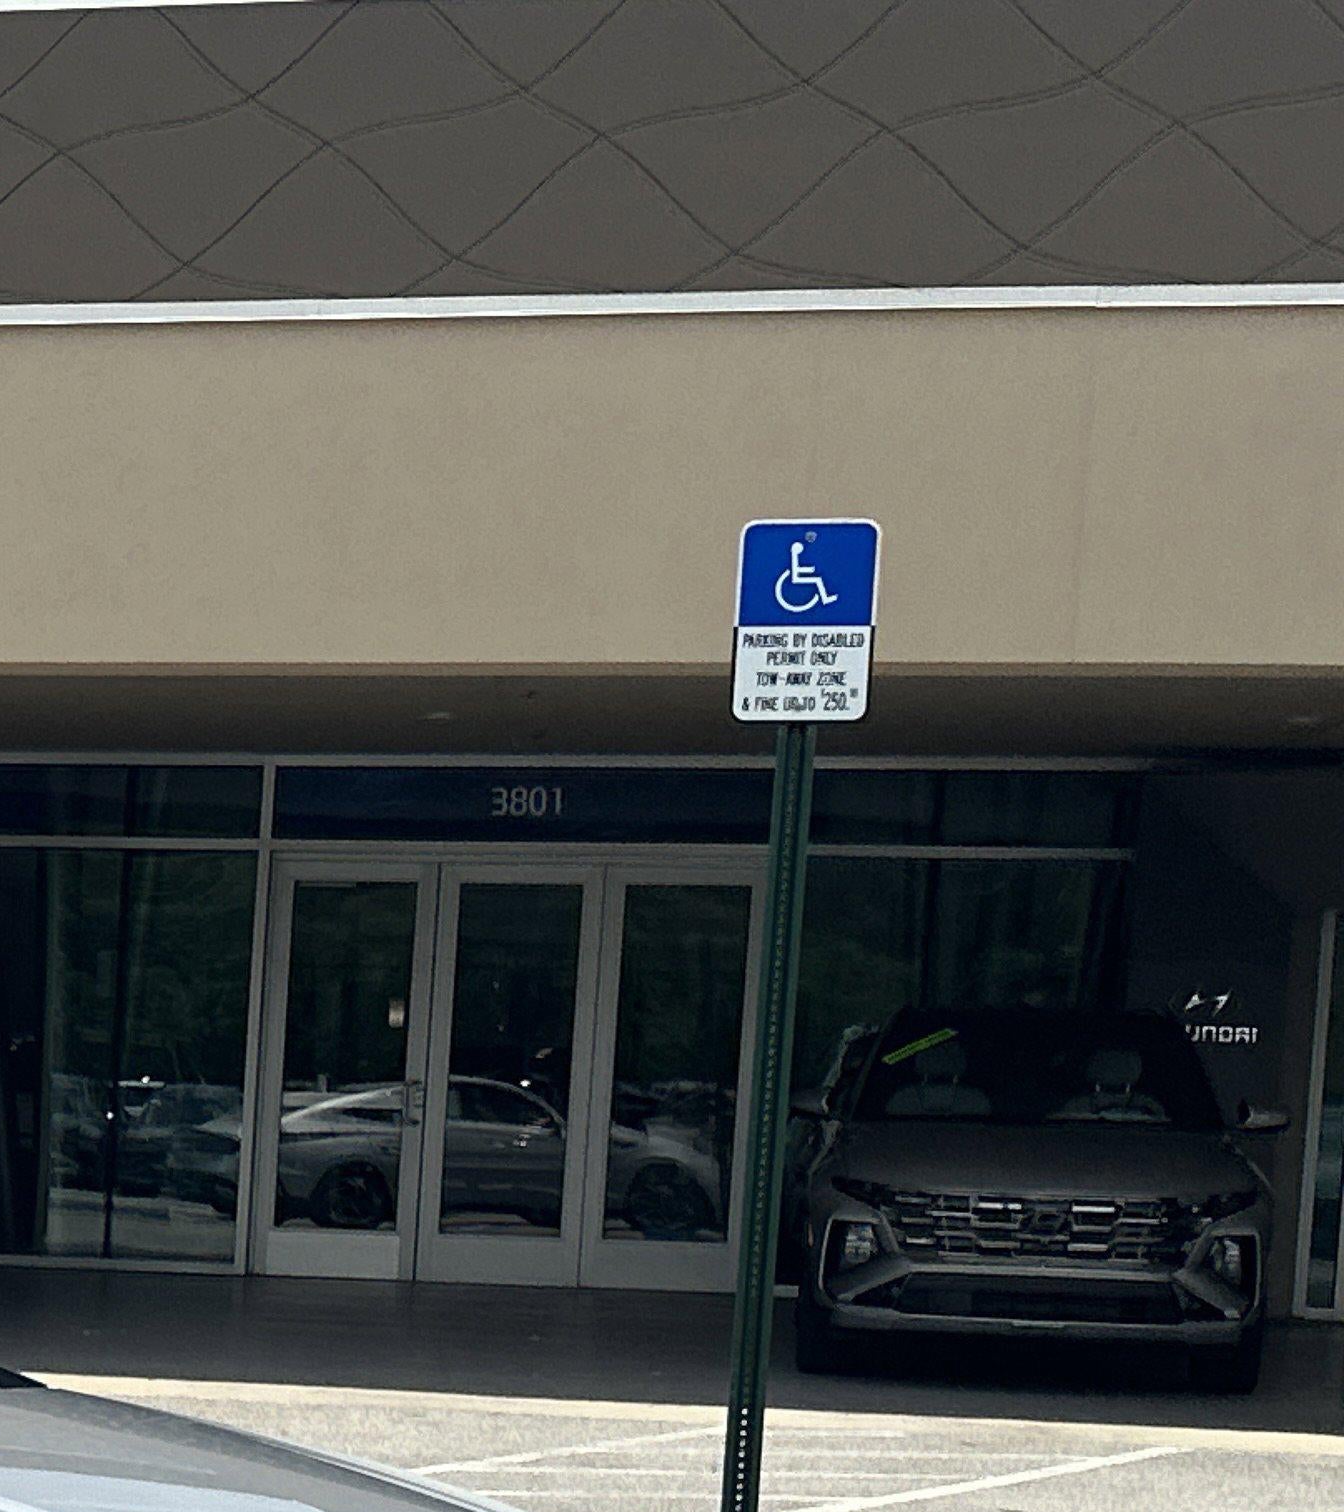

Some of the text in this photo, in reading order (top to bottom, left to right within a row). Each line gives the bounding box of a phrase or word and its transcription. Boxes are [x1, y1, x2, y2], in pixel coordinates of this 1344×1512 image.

[742, 633, 865, 648] PARKING BY DISABLED
[491, 786, 562, 817] 3801
[1185, 1024, 1259, 1044] UNDAI
